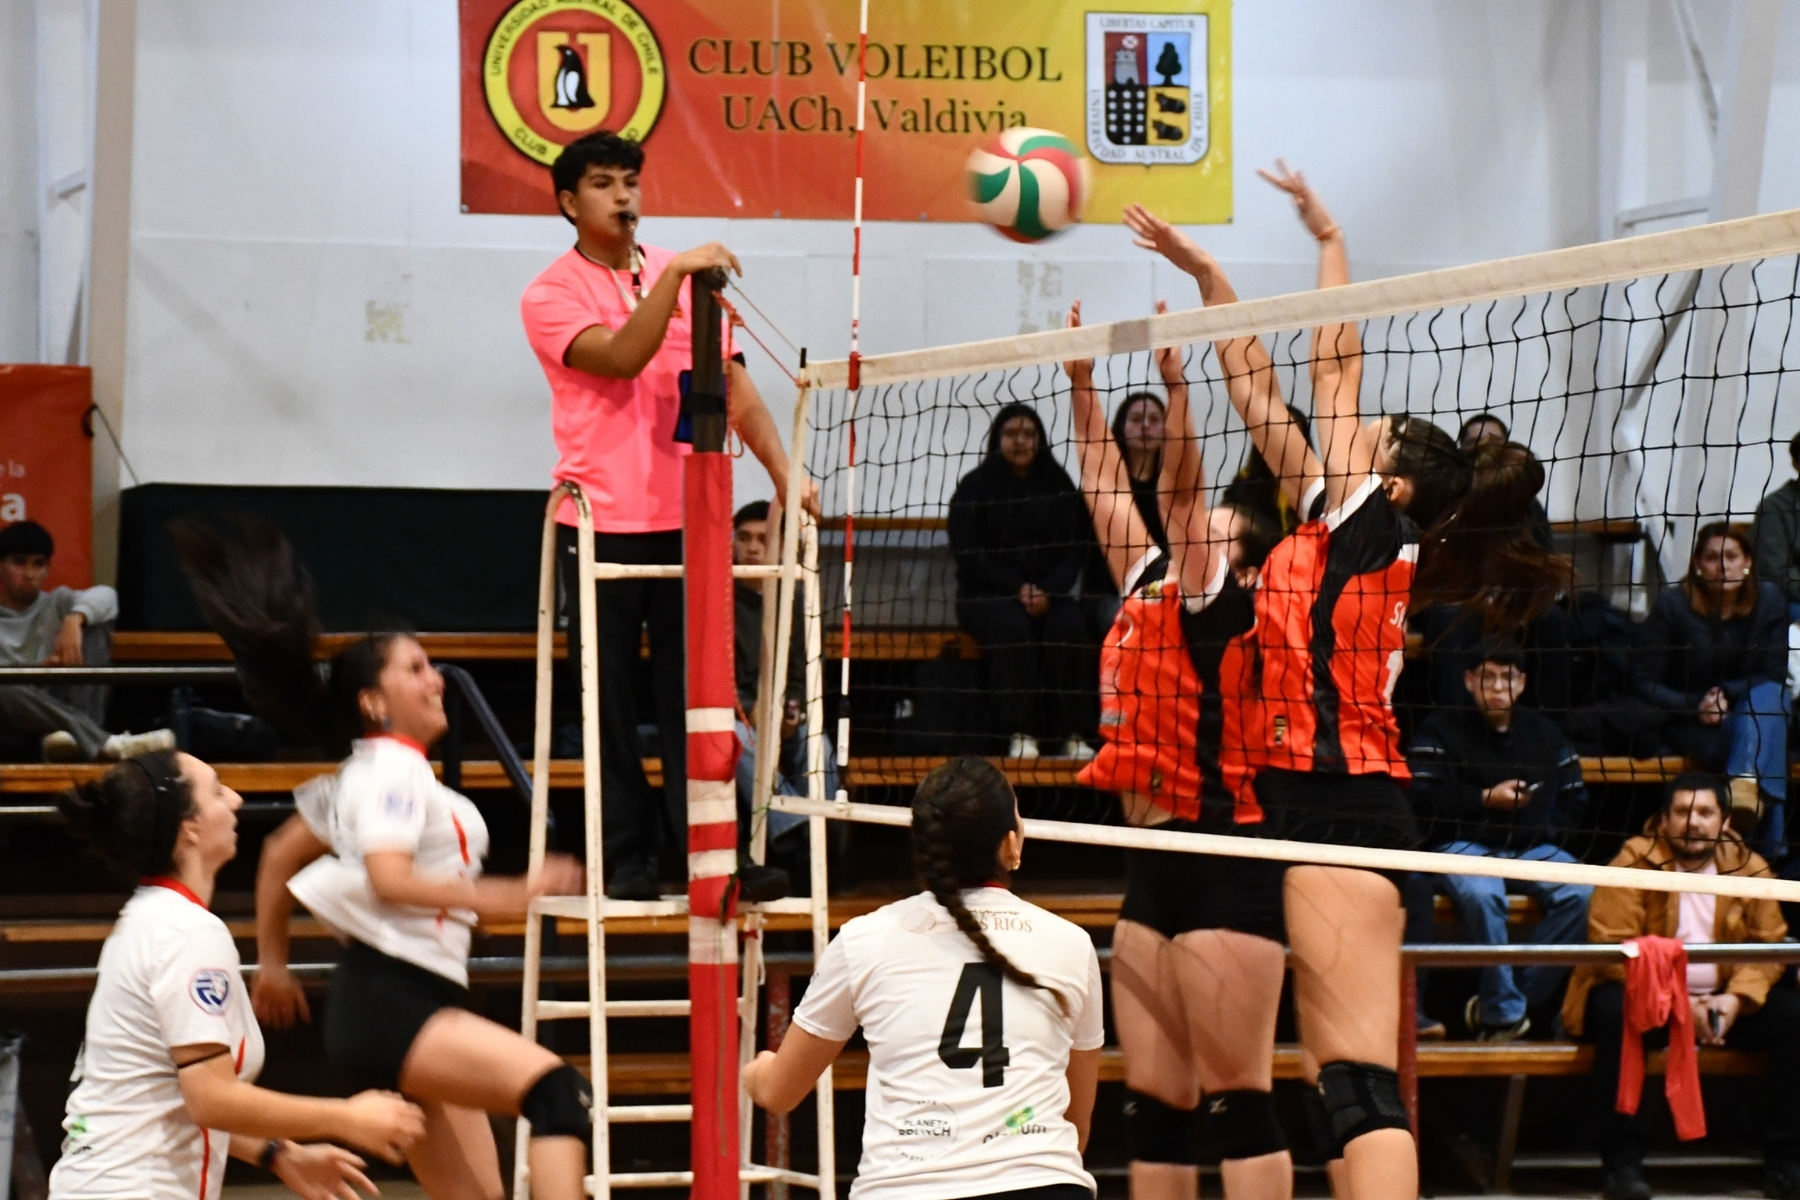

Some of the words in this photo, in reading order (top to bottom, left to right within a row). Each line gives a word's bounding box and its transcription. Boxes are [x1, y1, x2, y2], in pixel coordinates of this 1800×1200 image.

[620, 12, 639, 30] DE
[635, 31, 659, 75] CHILE
[1100, 17, 1147, 28] LIBERTAS
[687, 37, 813, 76] CLUB
[827, 41, 1063, 82] VOLEIBOL
[722, 94, 858, 137] UACh,
[869, 98, 1028, 135] Valdivia
[514, 126, 550, 156] CLUB
[994, 917, 1033, 933] RIOS
[937, 962, 1010, 1088] 4
